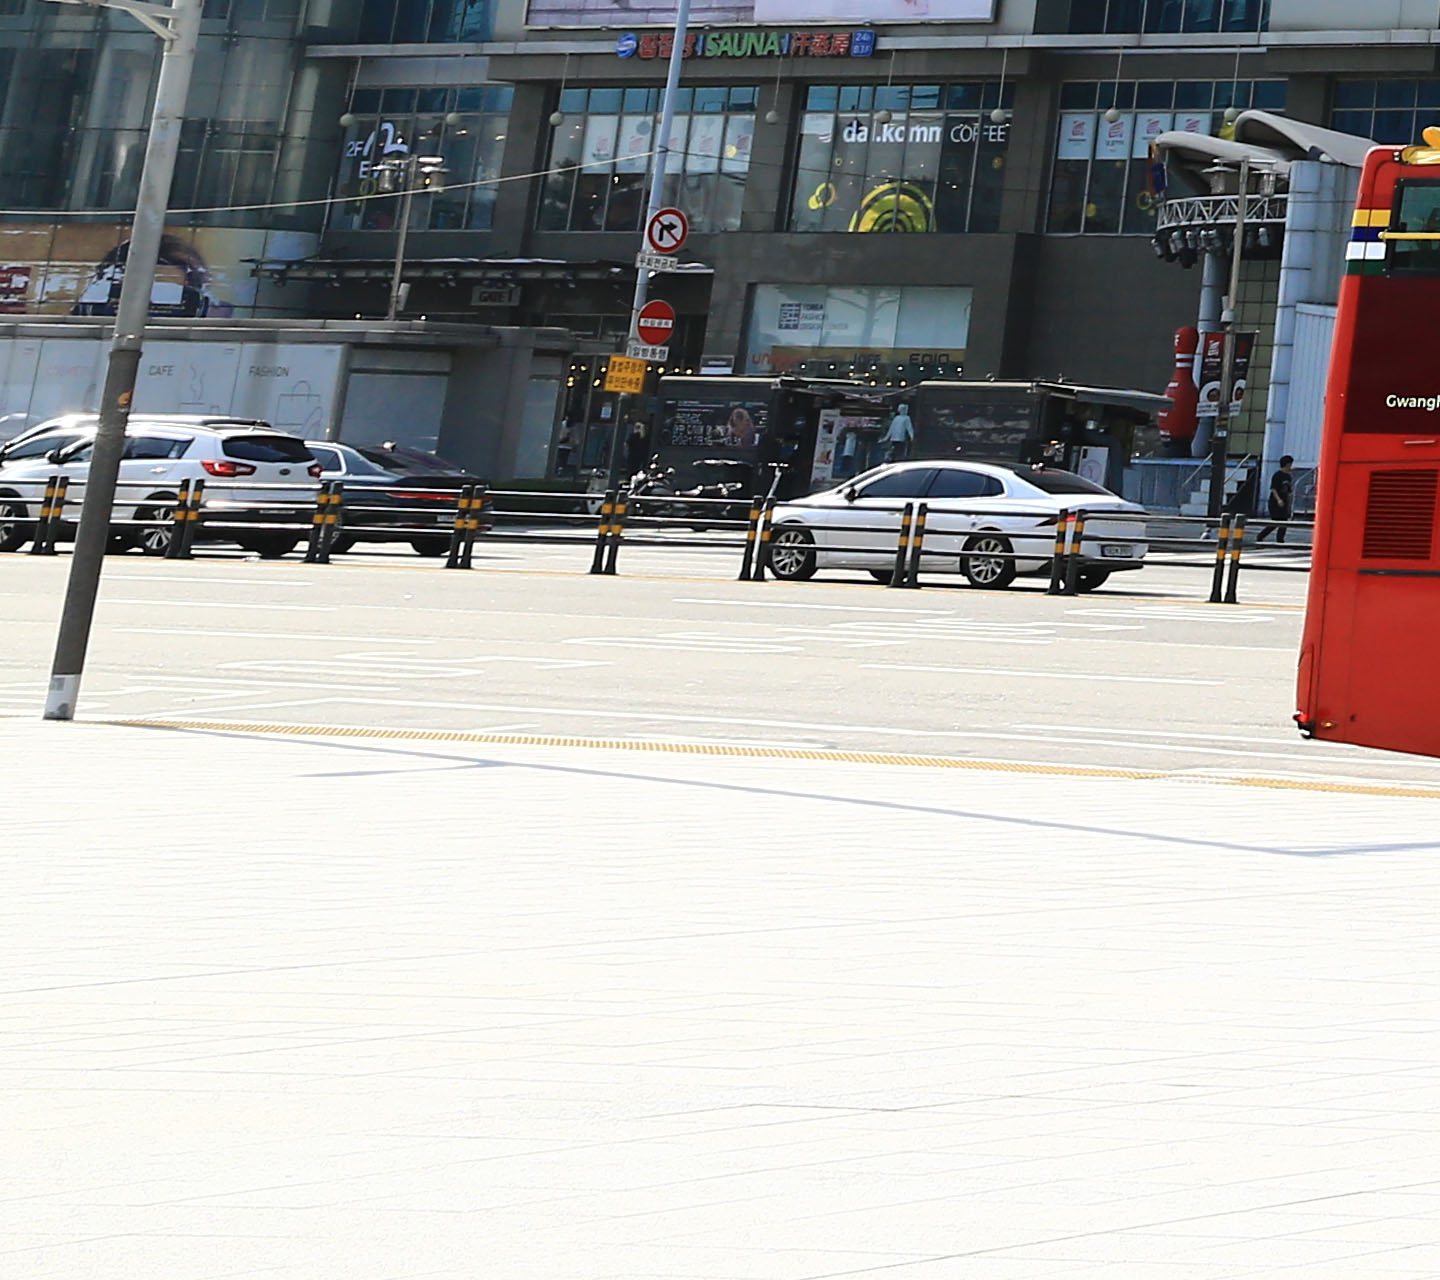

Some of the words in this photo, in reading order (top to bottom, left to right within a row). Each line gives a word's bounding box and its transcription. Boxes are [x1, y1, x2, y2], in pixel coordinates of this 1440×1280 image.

[704, 32, 780, 57] SAUNA
[951, 124, 1006, 143] COFFEE
[148, 365, 175, 377] CAFE
[249, 365, 290, 378] FASHION
